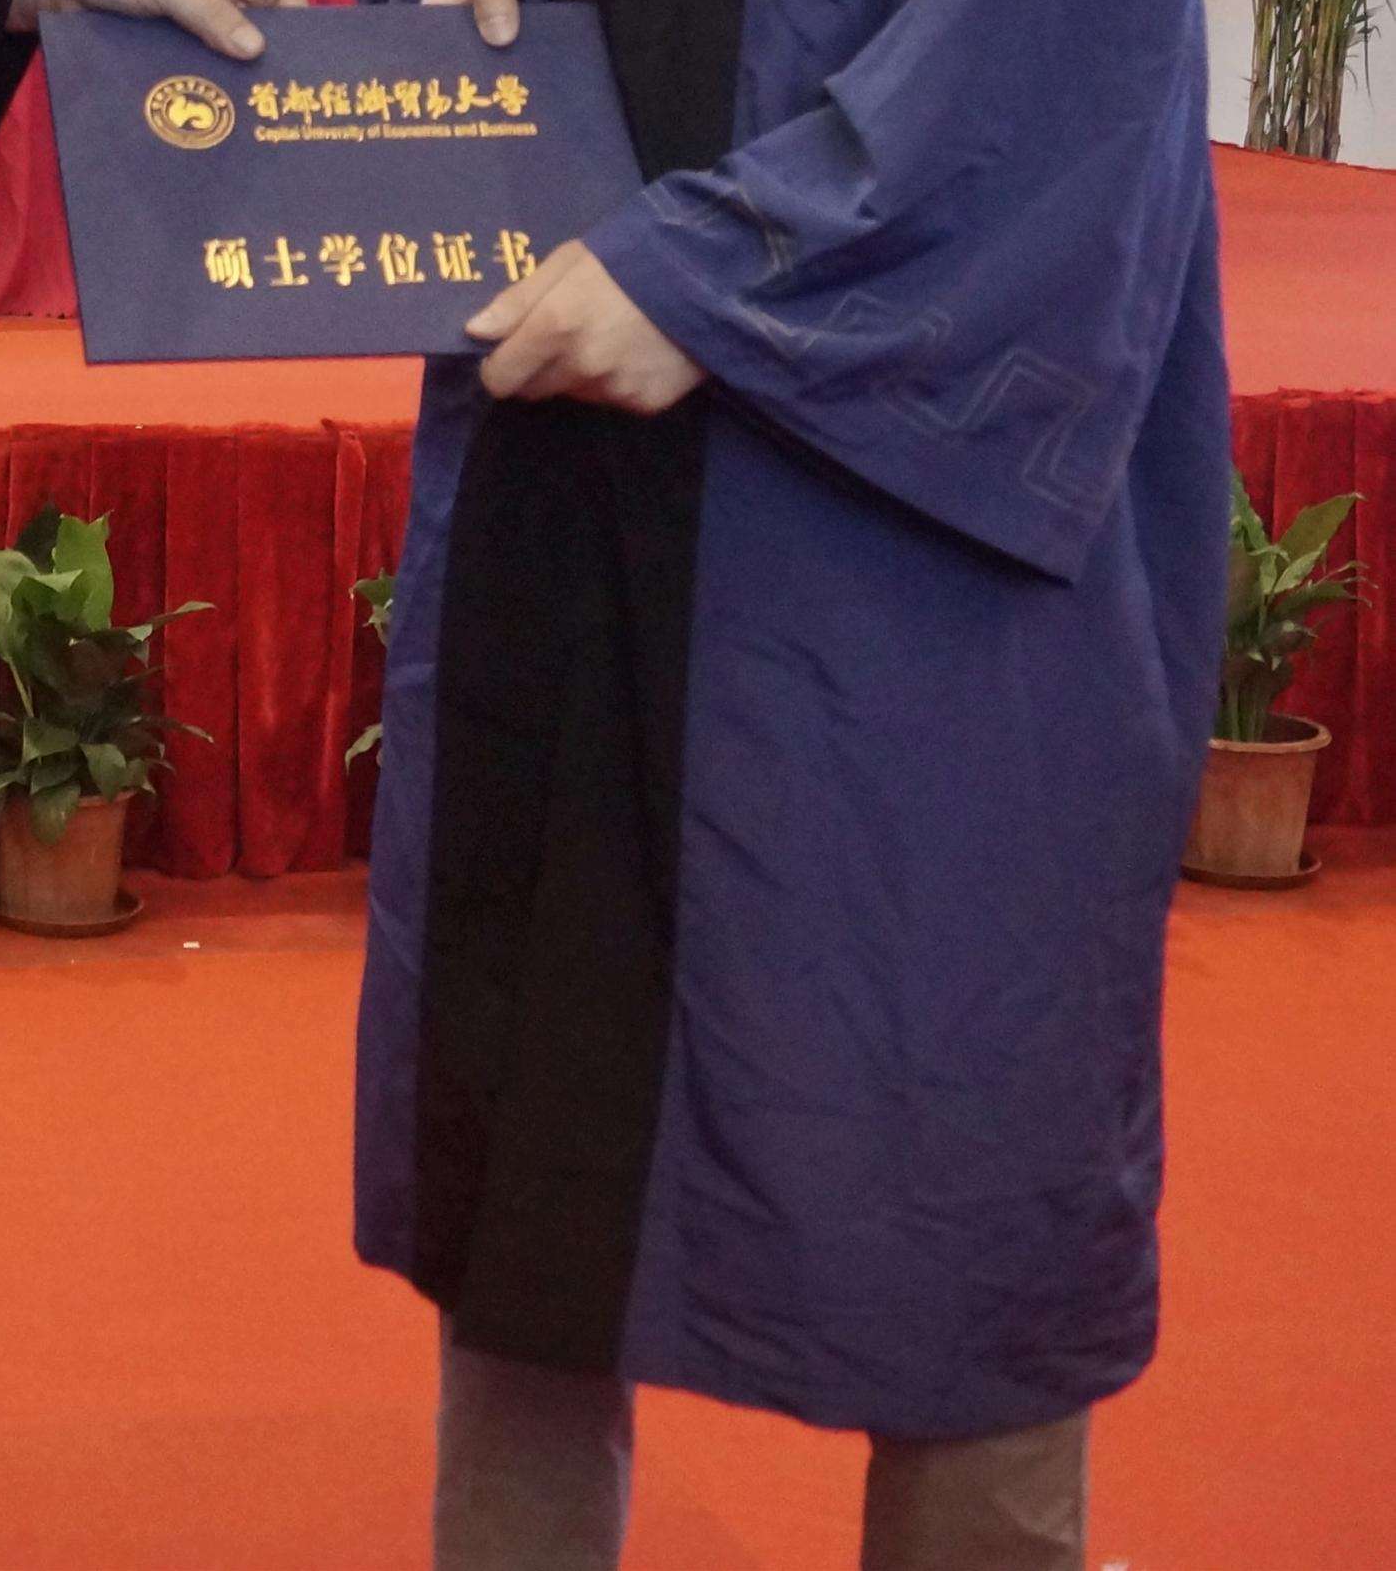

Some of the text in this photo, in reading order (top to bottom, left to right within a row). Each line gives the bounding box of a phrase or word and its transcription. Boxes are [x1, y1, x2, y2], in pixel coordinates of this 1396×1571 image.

[203, 229, 536, 289] 硕士学位证书
